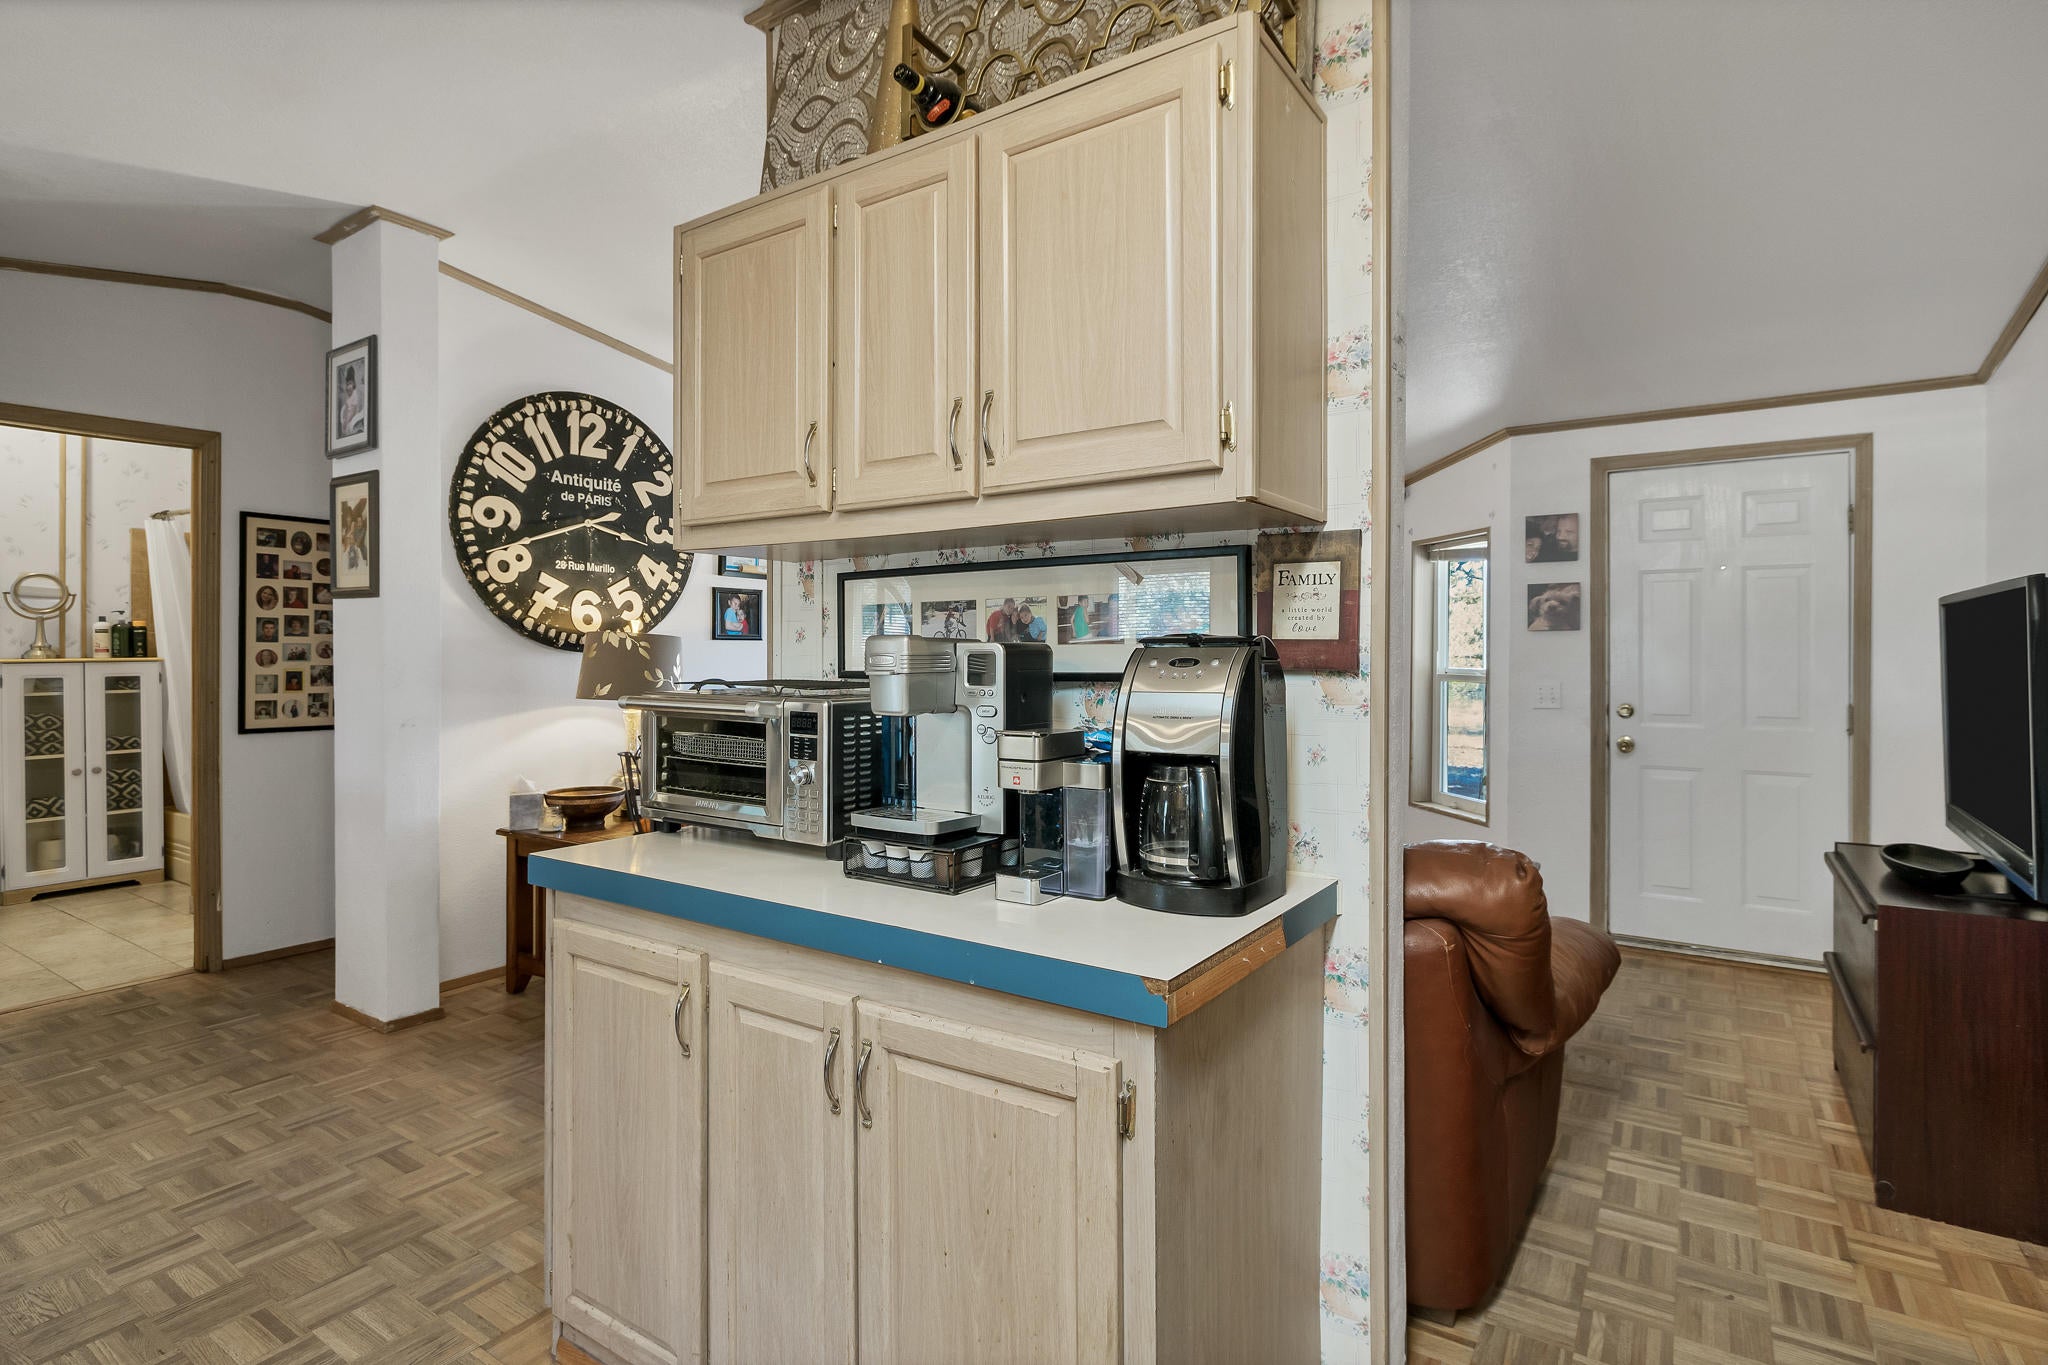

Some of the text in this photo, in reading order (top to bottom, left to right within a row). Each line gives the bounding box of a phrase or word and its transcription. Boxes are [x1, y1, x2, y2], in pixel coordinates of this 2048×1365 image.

[523, 413, 564, 464] 11
[567, 410, 608, 460] 12
[614, 434, 644, 472] 1
[482, 441, 537, 493] 10
[551, 469, 622, 493] Antiquité
[560, 491, 613, 507] de PARIS
[632, 470, 673, 509] 2
[472, 495, 522, 532] 9
[645, 515, 673, 545] 3
[486, 544, 532, 584] 8
[568, 560, 585, 571] Rue
[586, 562, 616, 574] Murillo
[636, 554, 675, 591] 4
[1278, 570, 1337, 586] FAMILY
[527, 571, 570, 620] 7
[571, 589, 602, 633] 6
[606, 576, 644, 621] 5
